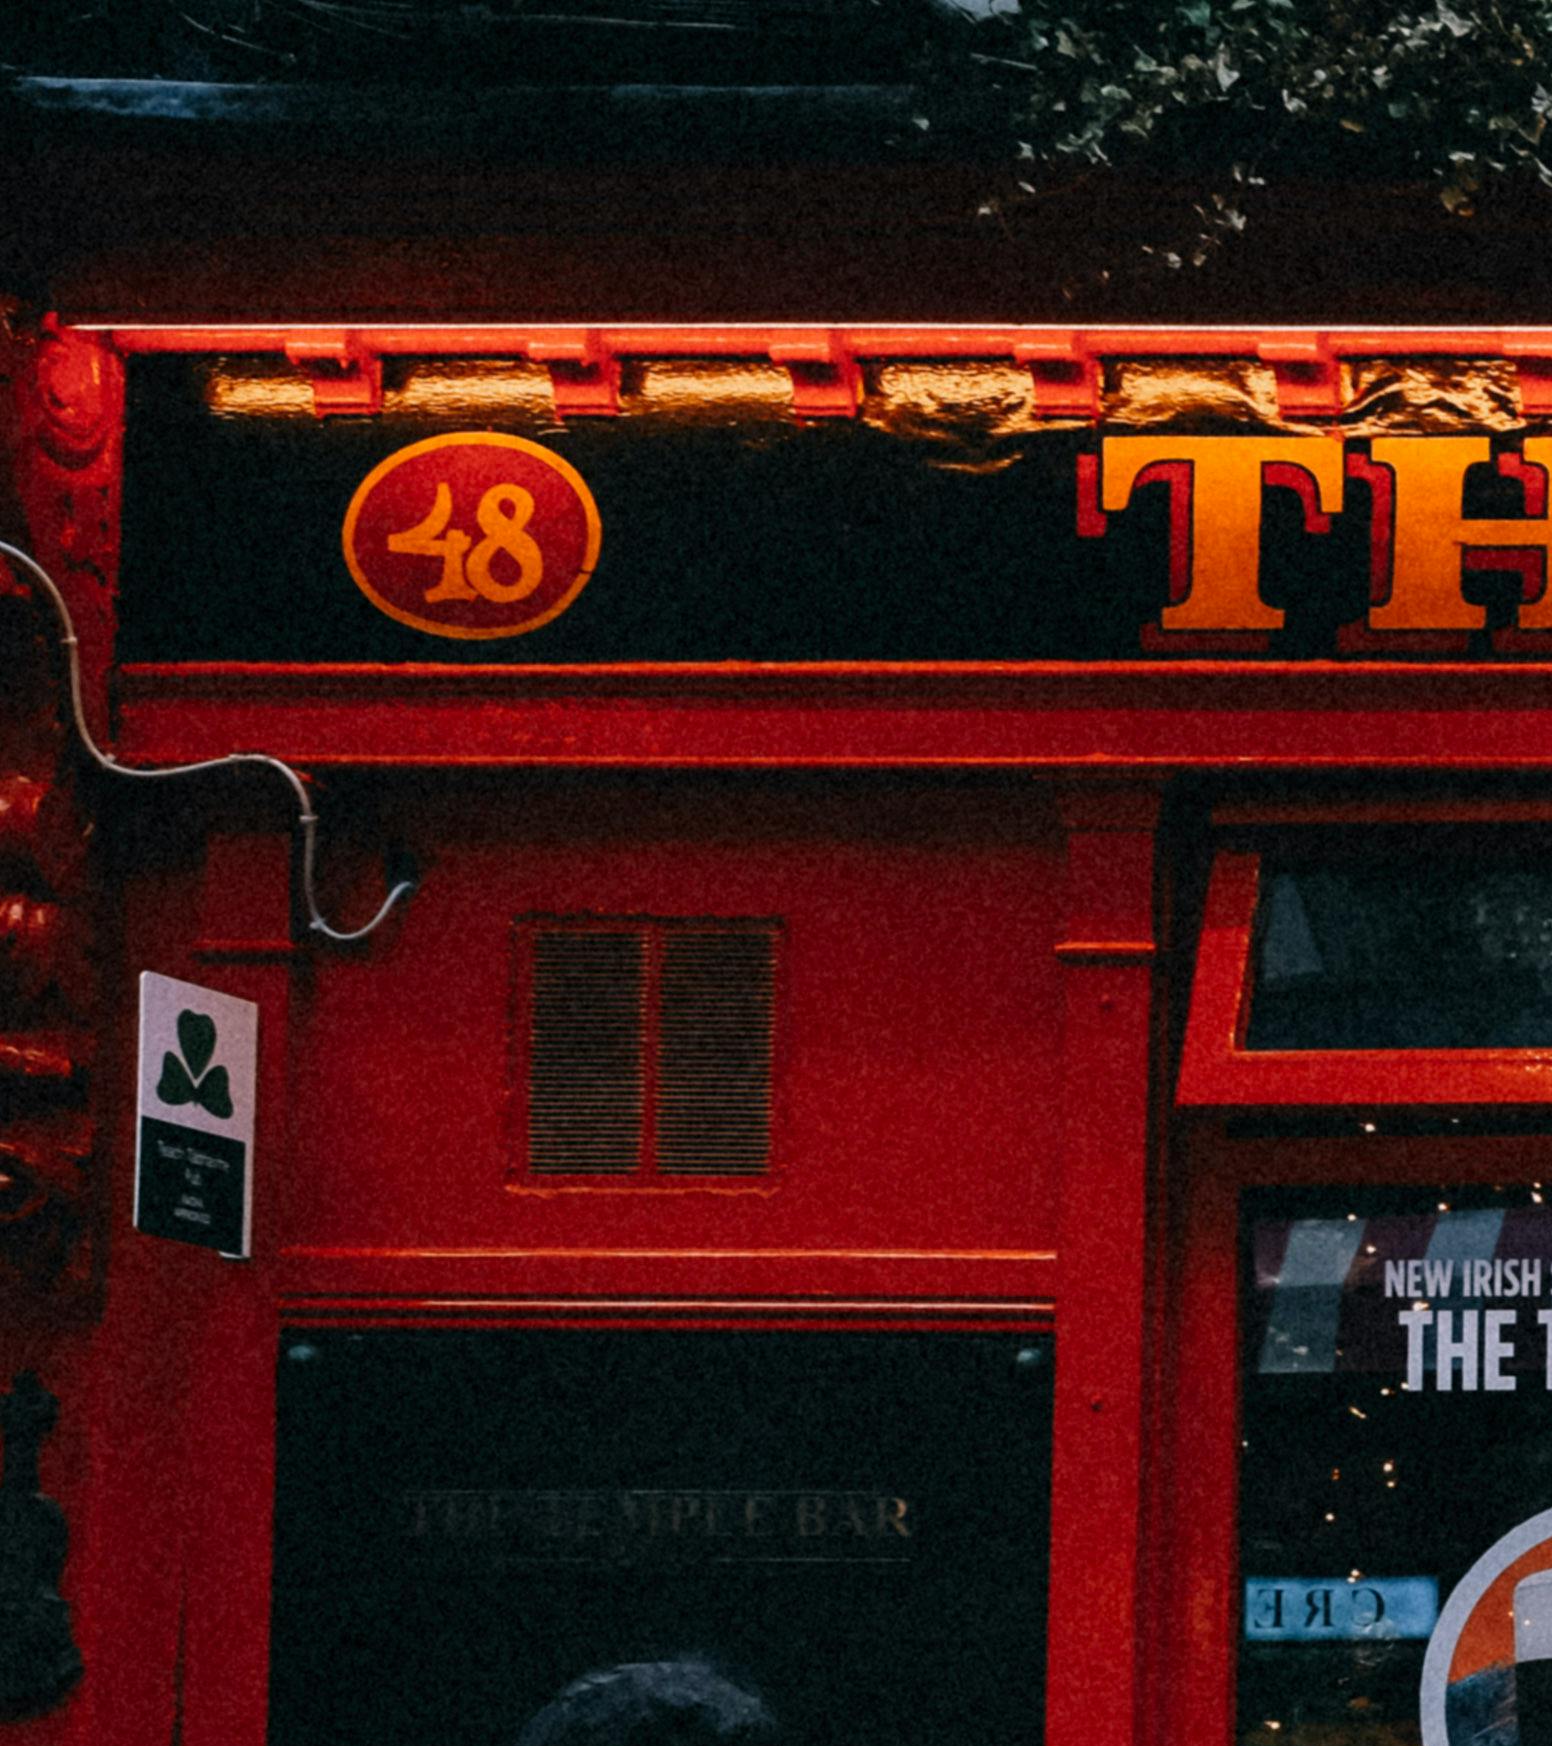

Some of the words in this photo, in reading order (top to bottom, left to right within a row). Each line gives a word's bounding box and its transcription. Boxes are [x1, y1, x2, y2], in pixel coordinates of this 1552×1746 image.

[387, 481, 545, 604] 48
[1385, 1259, 1456, 1298] NEW
[1462, 1259, 1541, 1298] IRISH
[1399, 1309, 1517, 1391] THE
[795, 1496, 911, 1539] BAR
